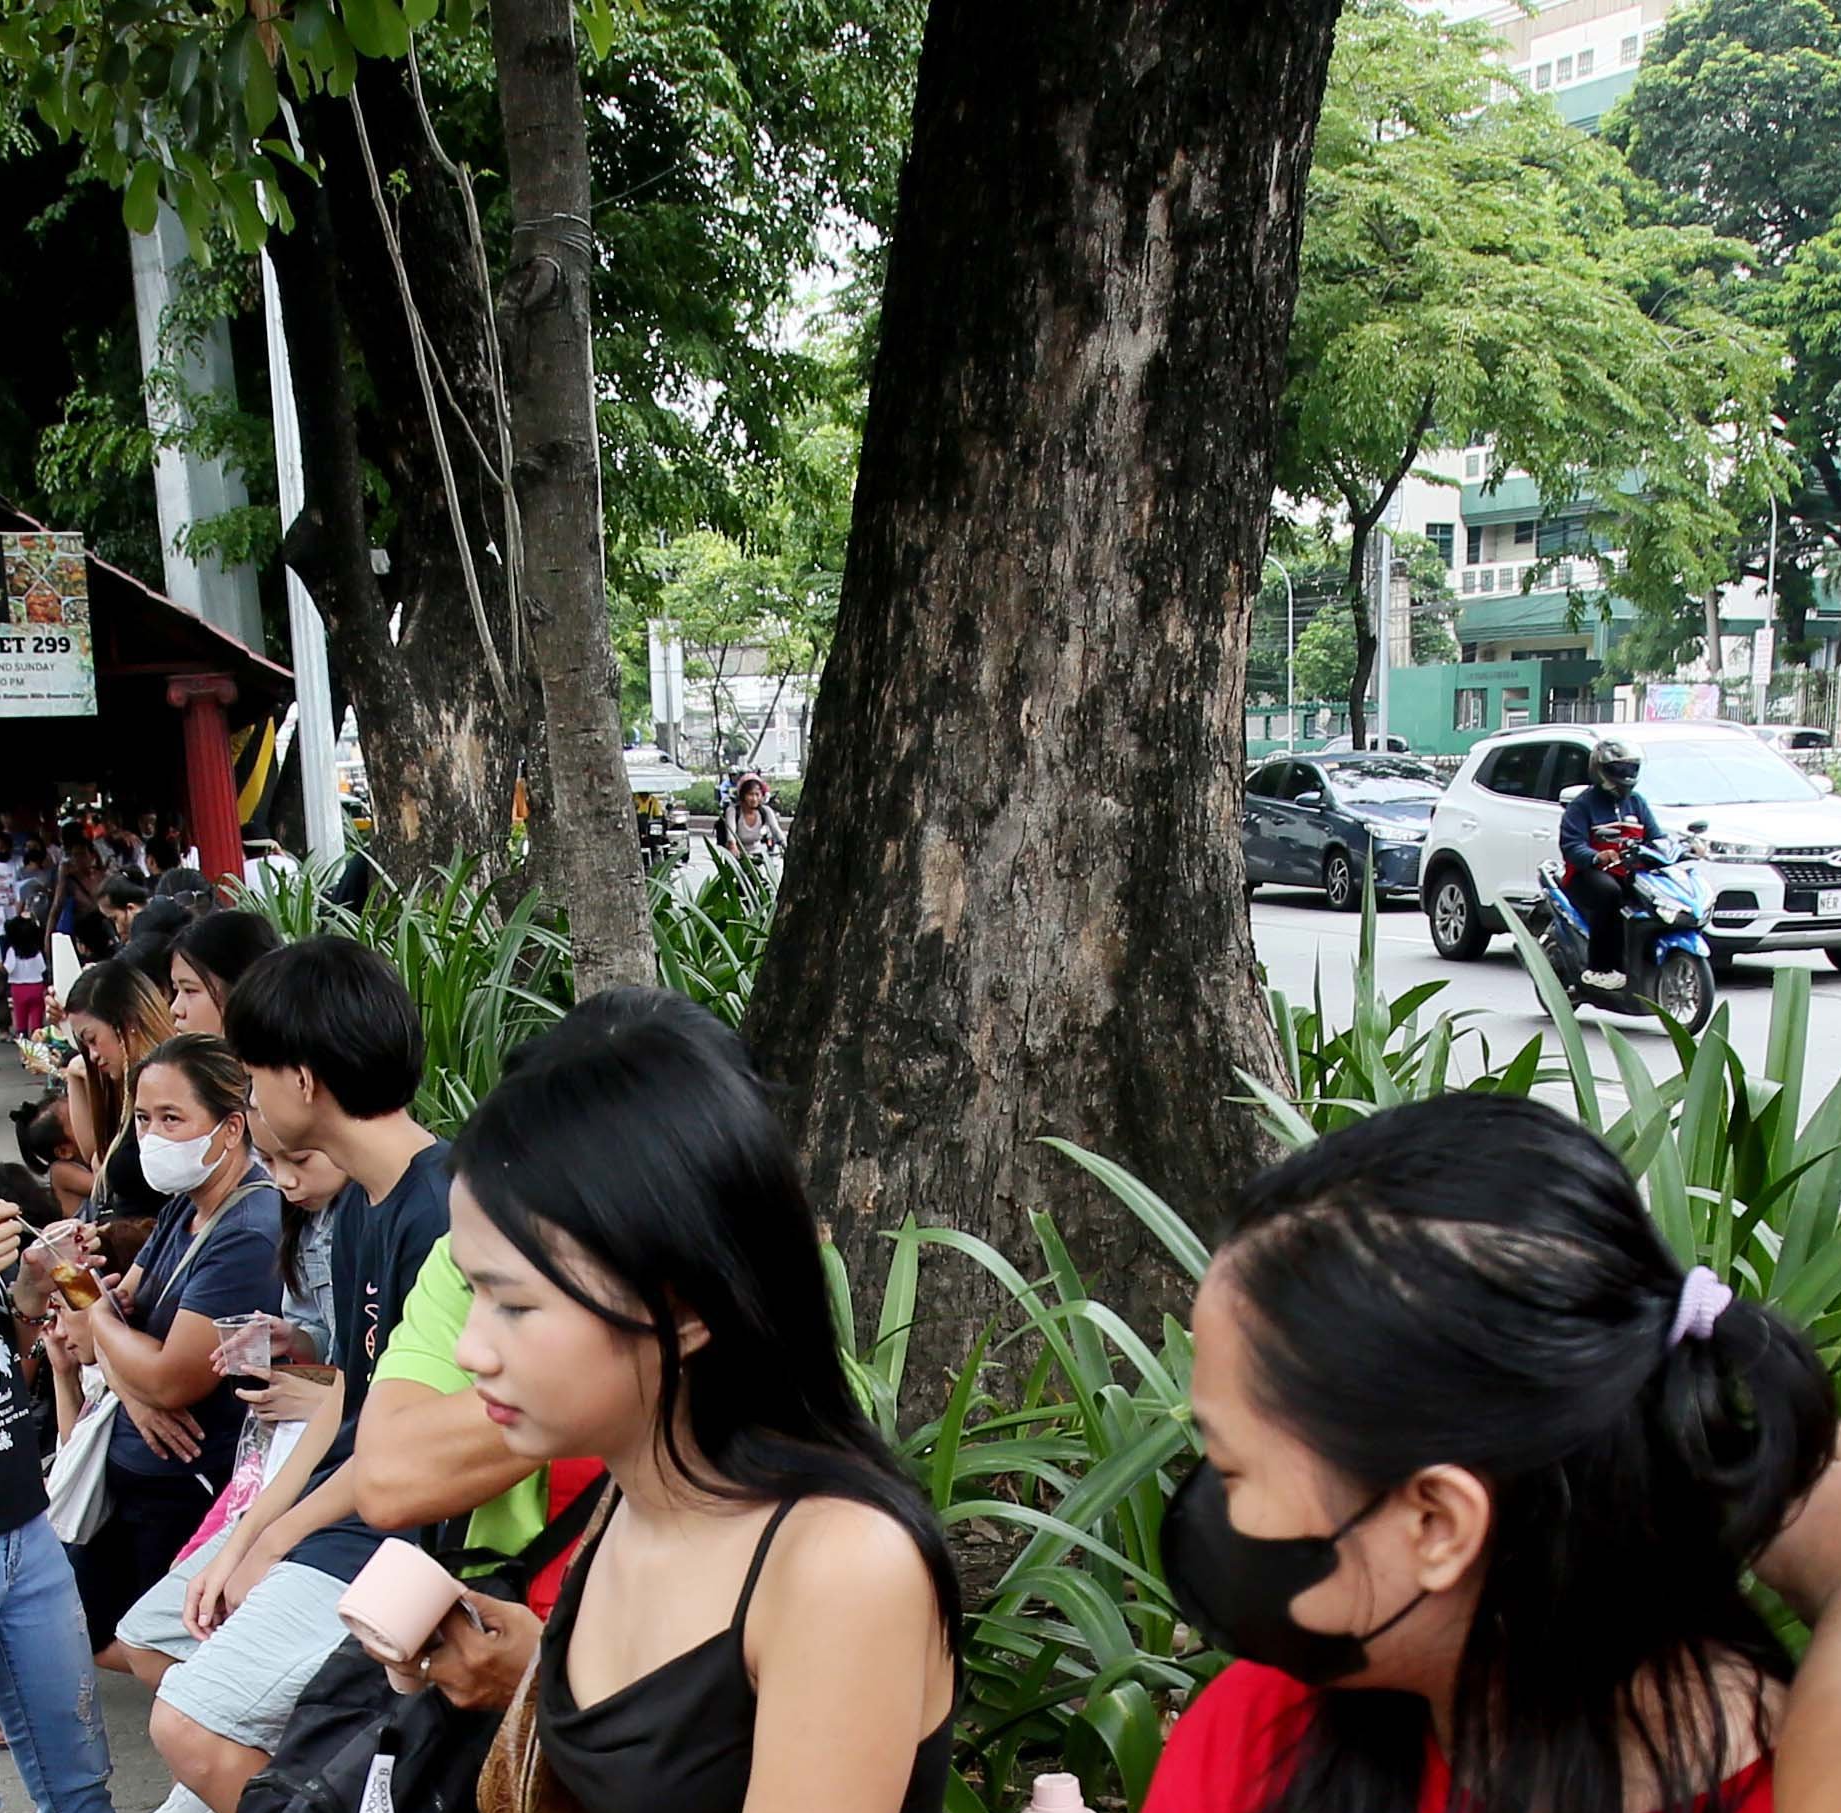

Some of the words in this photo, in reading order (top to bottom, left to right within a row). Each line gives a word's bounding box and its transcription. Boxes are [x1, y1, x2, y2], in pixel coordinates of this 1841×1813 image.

[32, 636, 71, 653] 299
[15, 663, 55, 671] SUNDAY
[9, 677, 25, 687] PM
